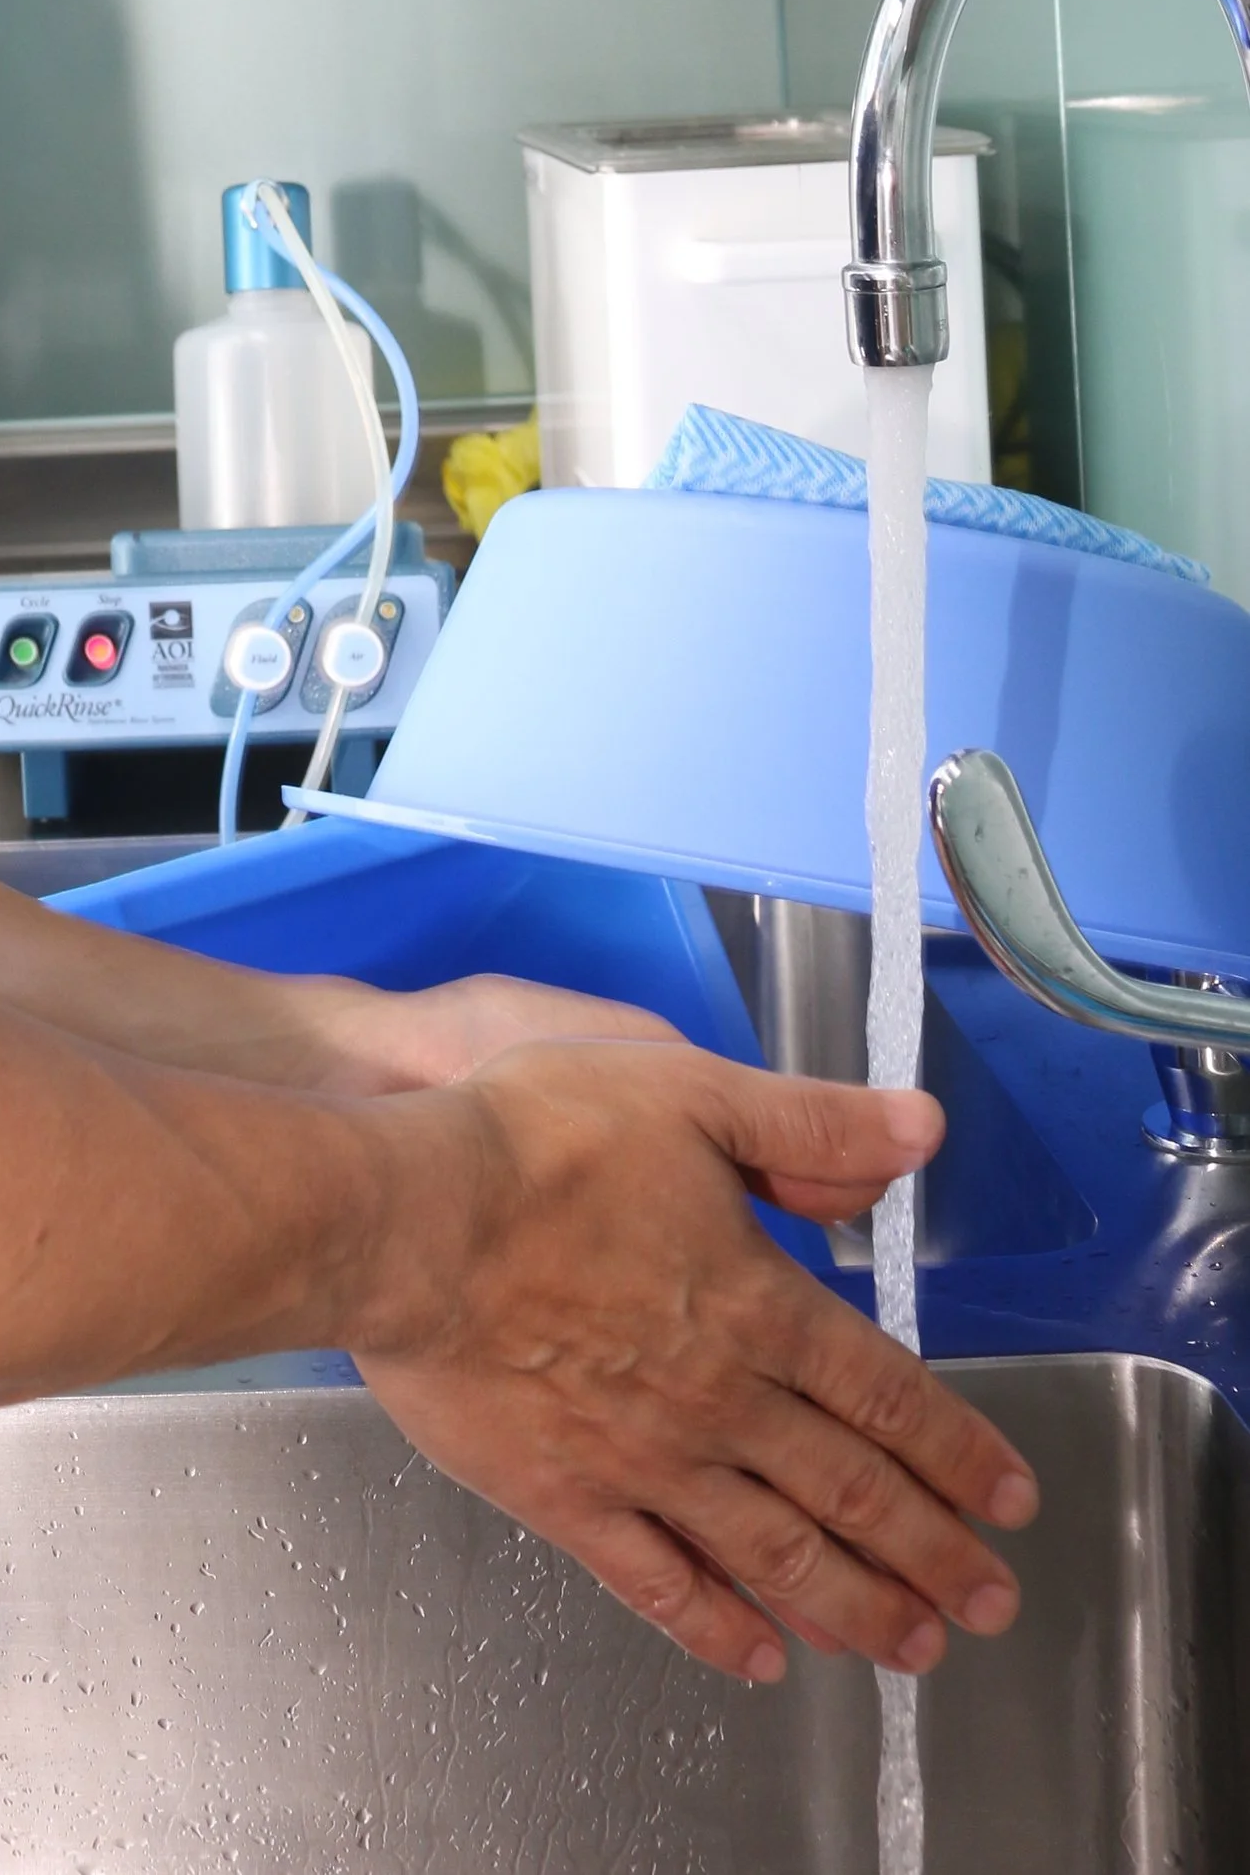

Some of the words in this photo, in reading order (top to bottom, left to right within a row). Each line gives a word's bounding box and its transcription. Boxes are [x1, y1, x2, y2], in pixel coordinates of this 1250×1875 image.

[20, 595, 50, 609] Cycle
[98, 593, 122, 608] Stop
[152, 640, 194, 662] AOI
[251, 653, 278, 664] Fluid
